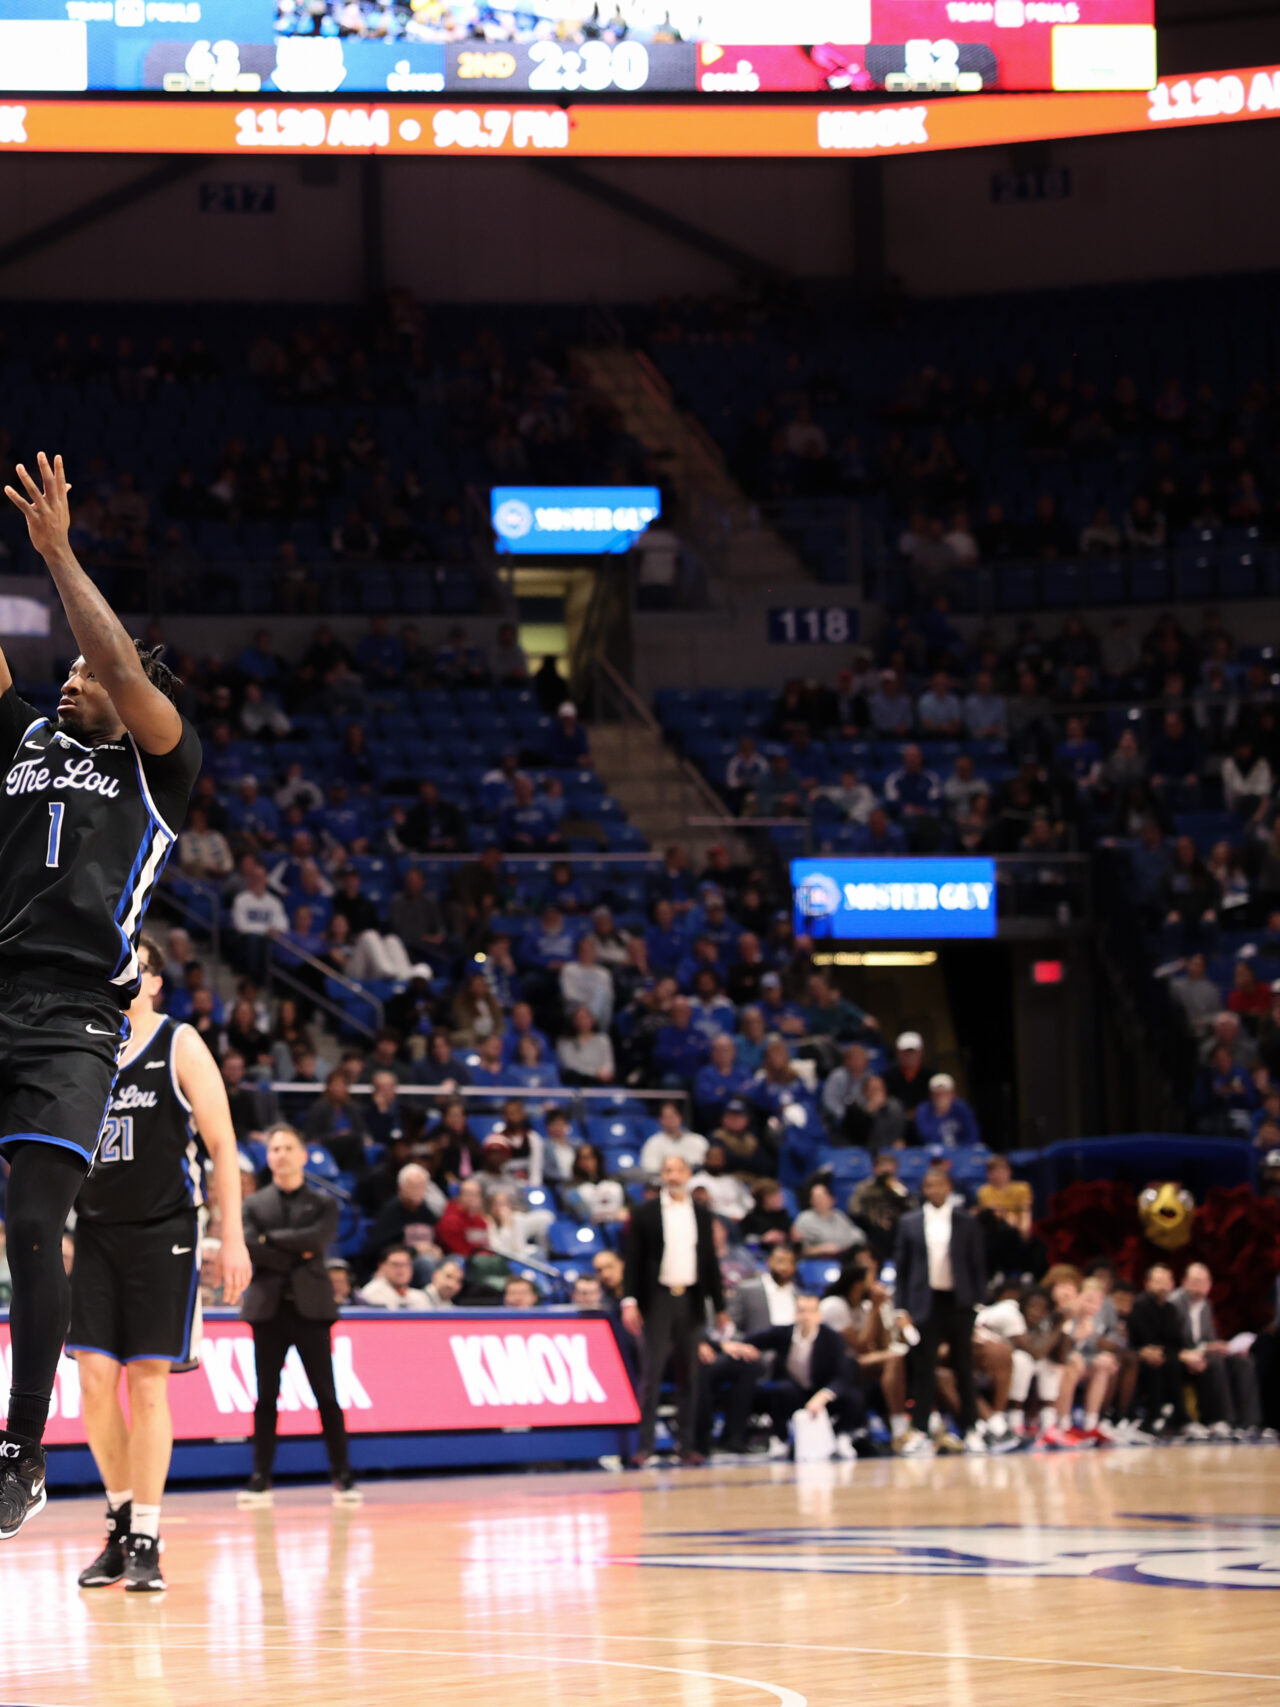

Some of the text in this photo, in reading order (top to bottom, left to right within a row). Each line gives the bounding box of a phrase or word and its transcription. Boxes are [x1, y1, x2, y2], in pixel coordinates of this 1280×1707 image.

[527, 41, 649, 91] 2:30
[778, 607, 848, 642] 118
[6, 756, 120, 798] The Lou
[45, 802, 65, 868] 1
[938, 882, 994, 911] GUY
[113, 1084, 158, 1110] Lou
[99, 1115, 134, 1163] 21
[448, 1333, 608, 1406] KMOX
